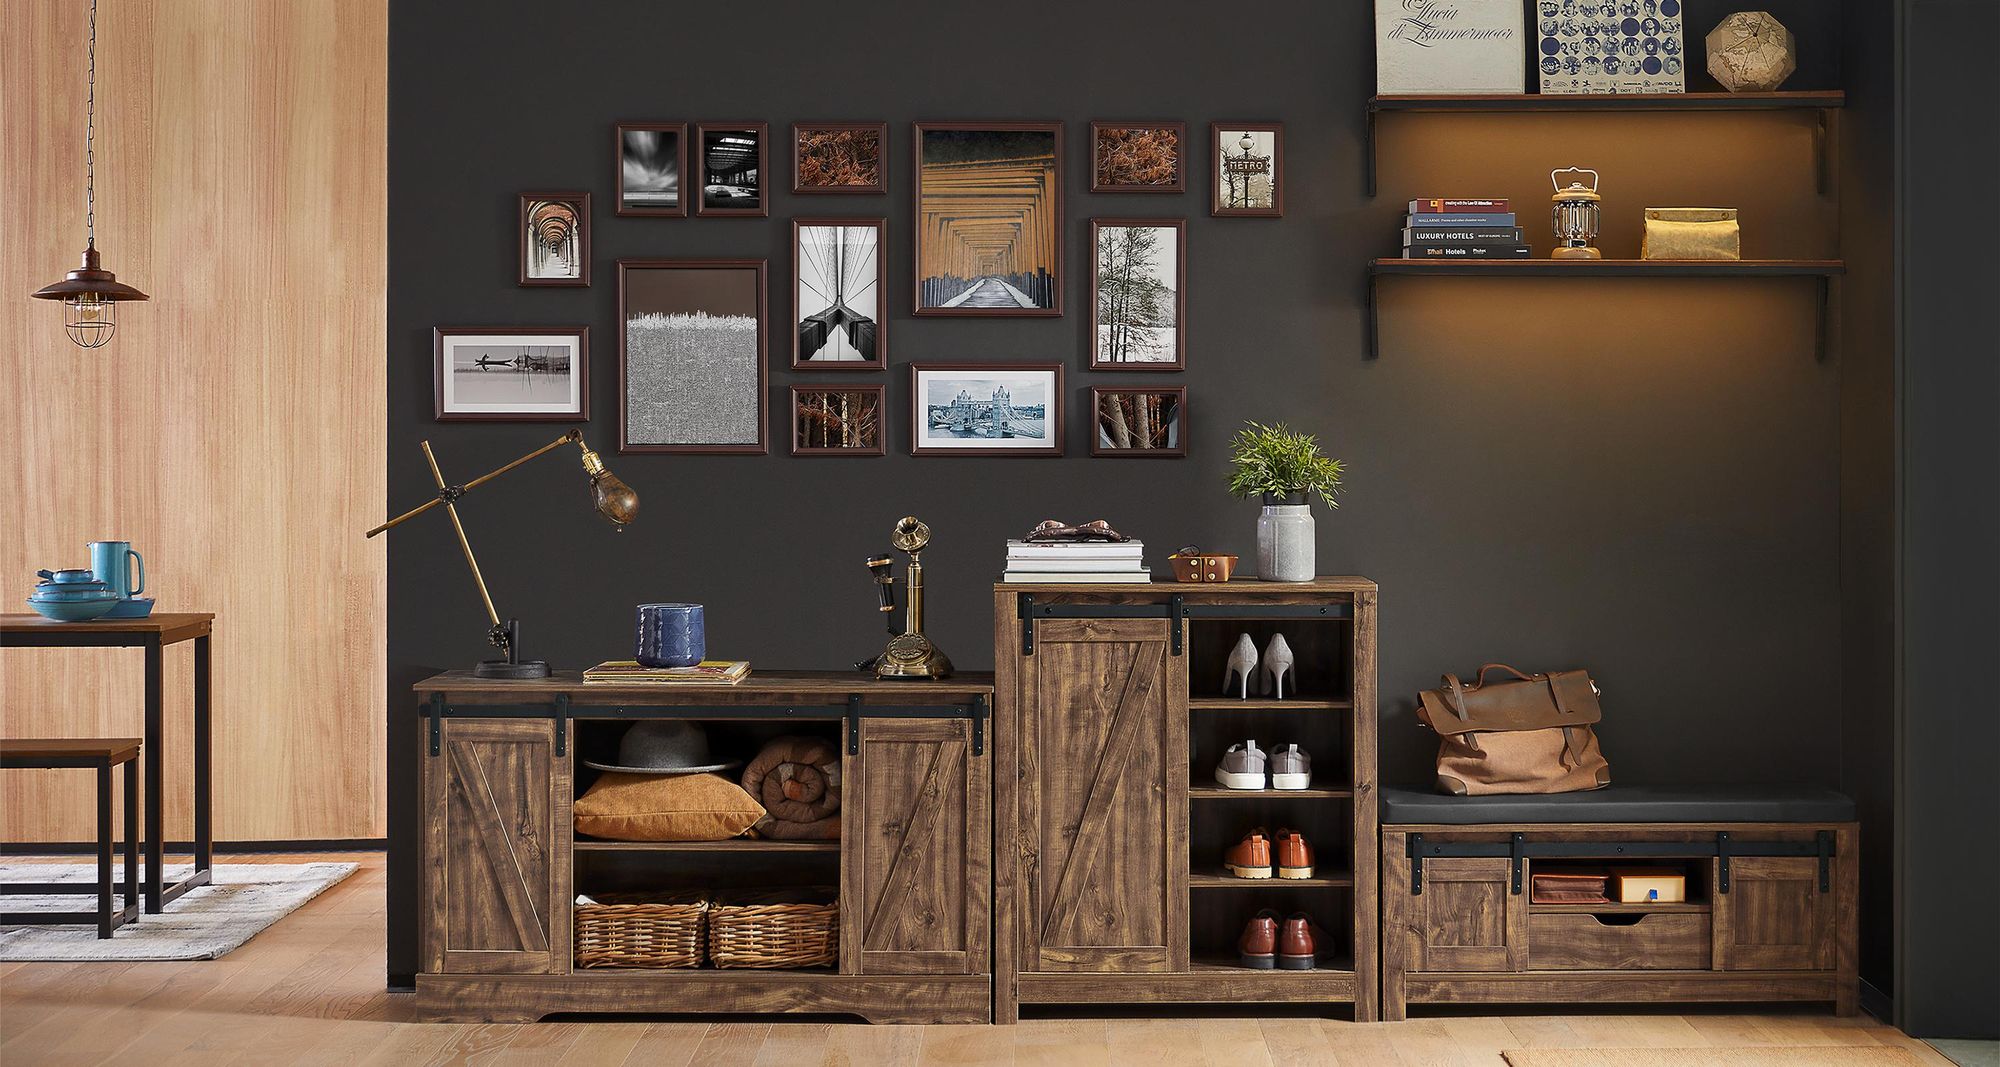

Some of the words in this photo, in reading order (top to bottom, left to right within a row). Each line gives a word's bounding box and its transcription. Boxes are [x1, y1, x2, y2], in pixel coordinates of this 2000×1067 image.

[1387, 23, 1407, 40] di
[1230, 161, 1263, 170] METRO
[1416, 232, 1445, 240] LUXURY
[1446, 232, 1474, 240] HOTELS
